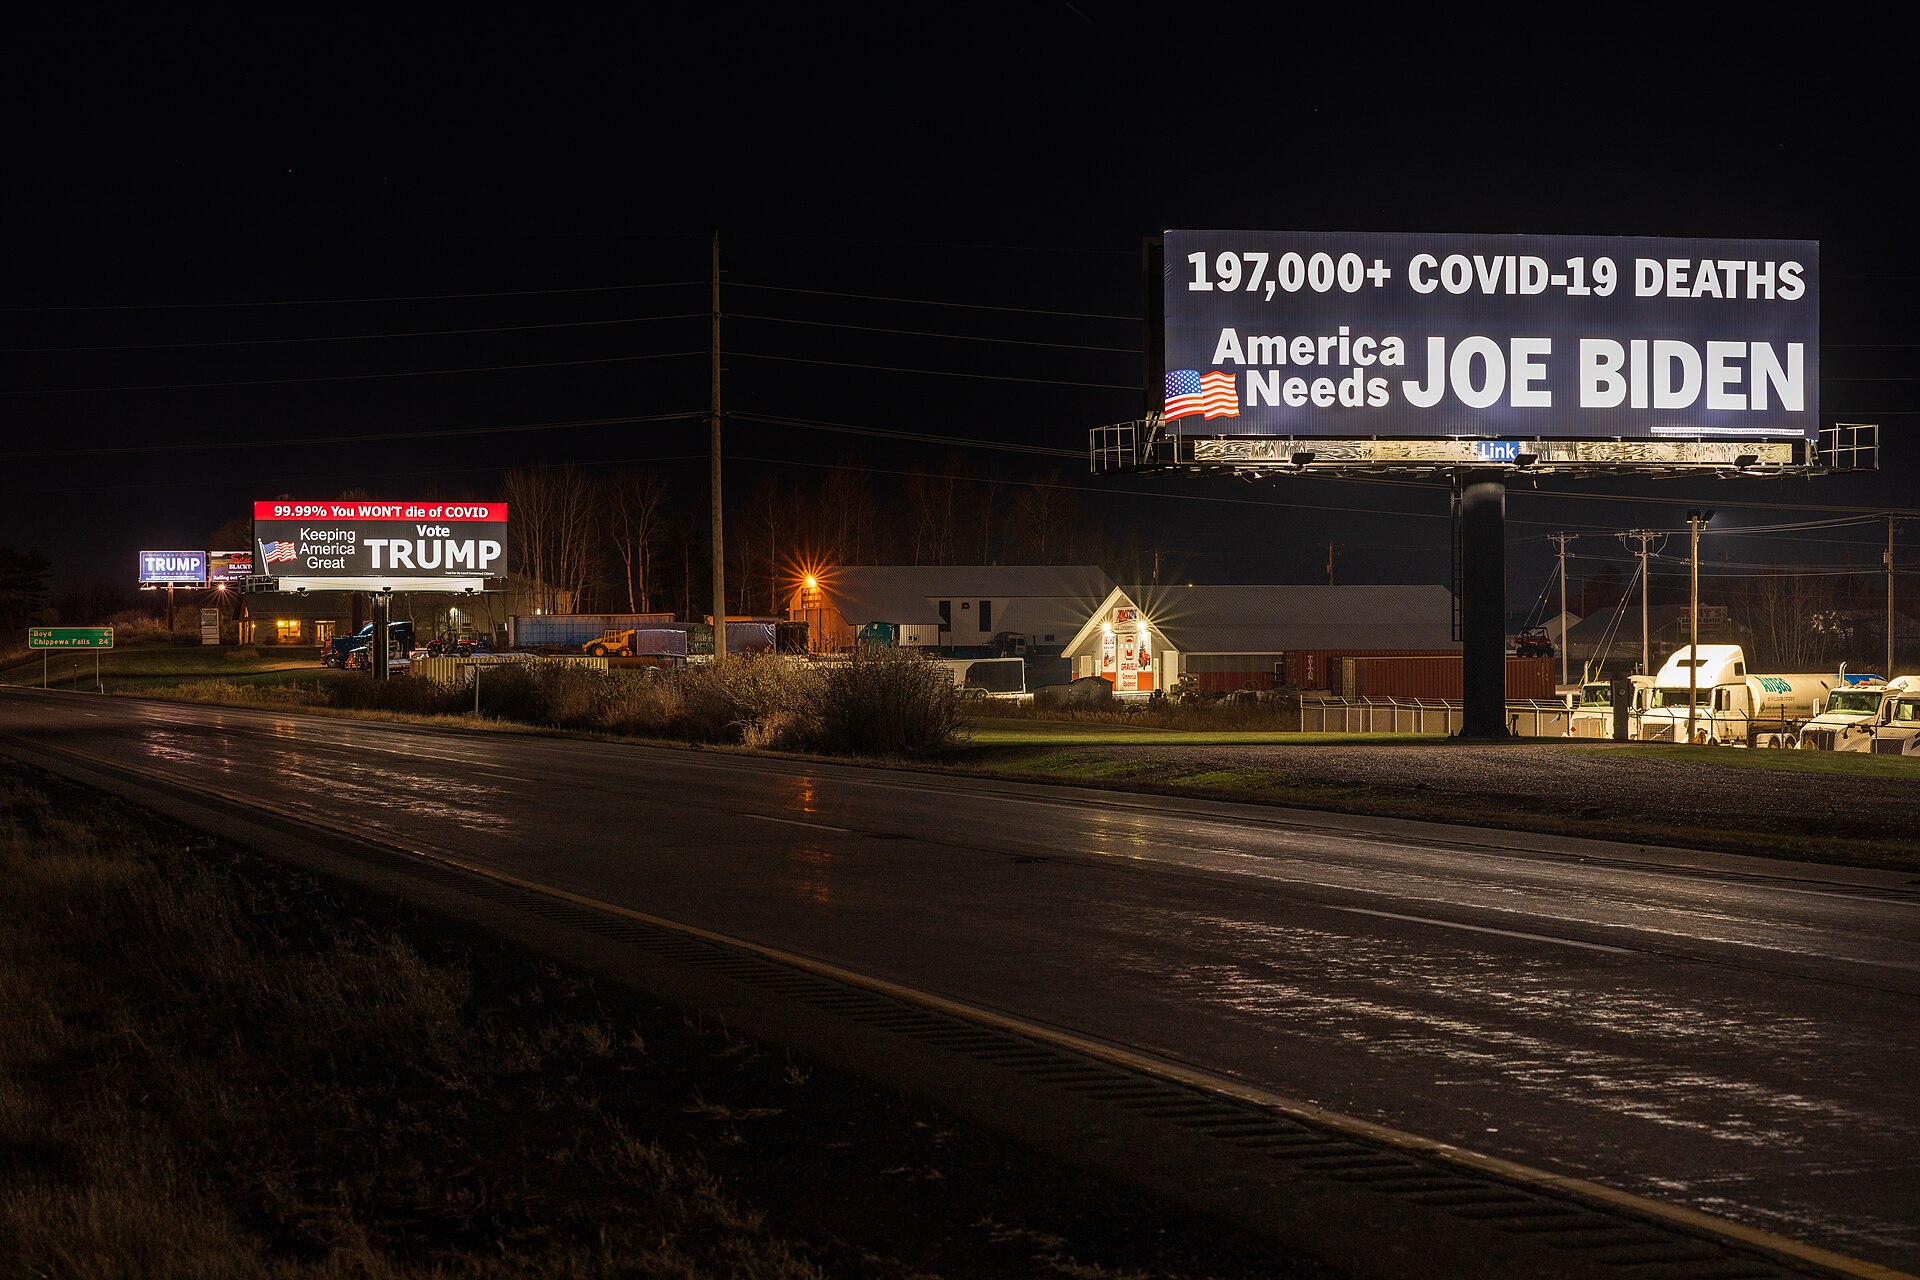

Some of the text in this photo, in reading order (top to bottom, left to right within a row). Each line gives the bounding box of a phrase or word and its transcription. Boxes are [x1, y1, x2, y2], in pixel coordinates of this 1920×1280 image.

[1187, 250, 1806, 301] 197,000+ COVID-19 DEATHS
[1213, 326, 1405, 367] America
[1401, 336, 1806, 413] JOE BIDEN
[1245, 368, 1390, 408] Needs
[1481, 442, 1516, 459] Link
[274, 505, 489, 518] 99.99% You WON'T die of COVID
[300, 528, 356, 543] Keeping
[416, 525, 451, 537] Vote
[299, 543, 356, 555] America
[363, 538, 502, 570] TRUMP
[145, 557, 200, 571] TRUMP
[306, 556, 345, 569] Great
[1754, 676, 1792, 694] Airgas
